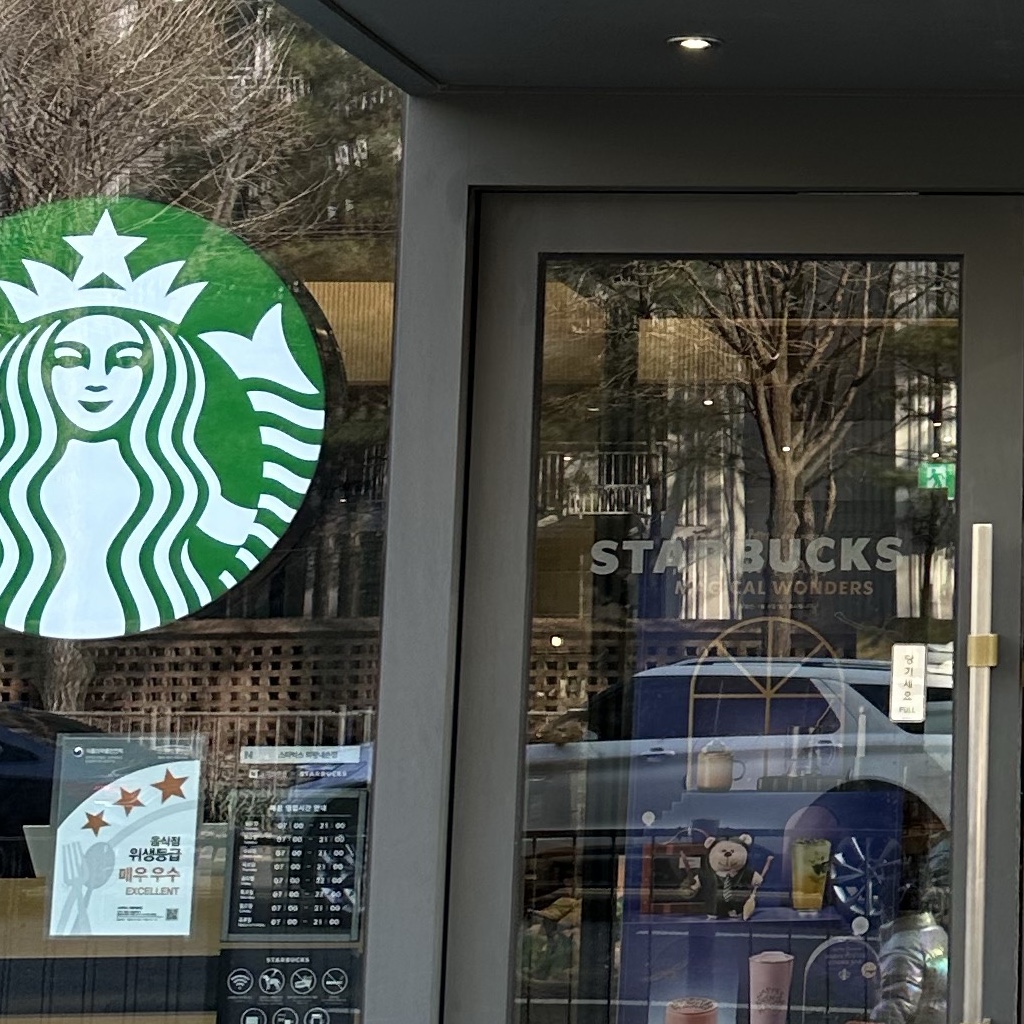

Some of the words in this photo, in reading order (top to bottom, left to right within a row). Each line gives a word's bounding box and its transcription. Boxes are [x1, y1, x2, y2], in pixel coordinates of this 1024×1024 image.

[772, 579, 874, 597] WONDERS
[903, 654, 914, 701] 당기세요
[150, 836, 181, 847] 음식점
[128, 847, 182, 862] 위생등급
[125, 887, 179, 896] EXCELLENT
